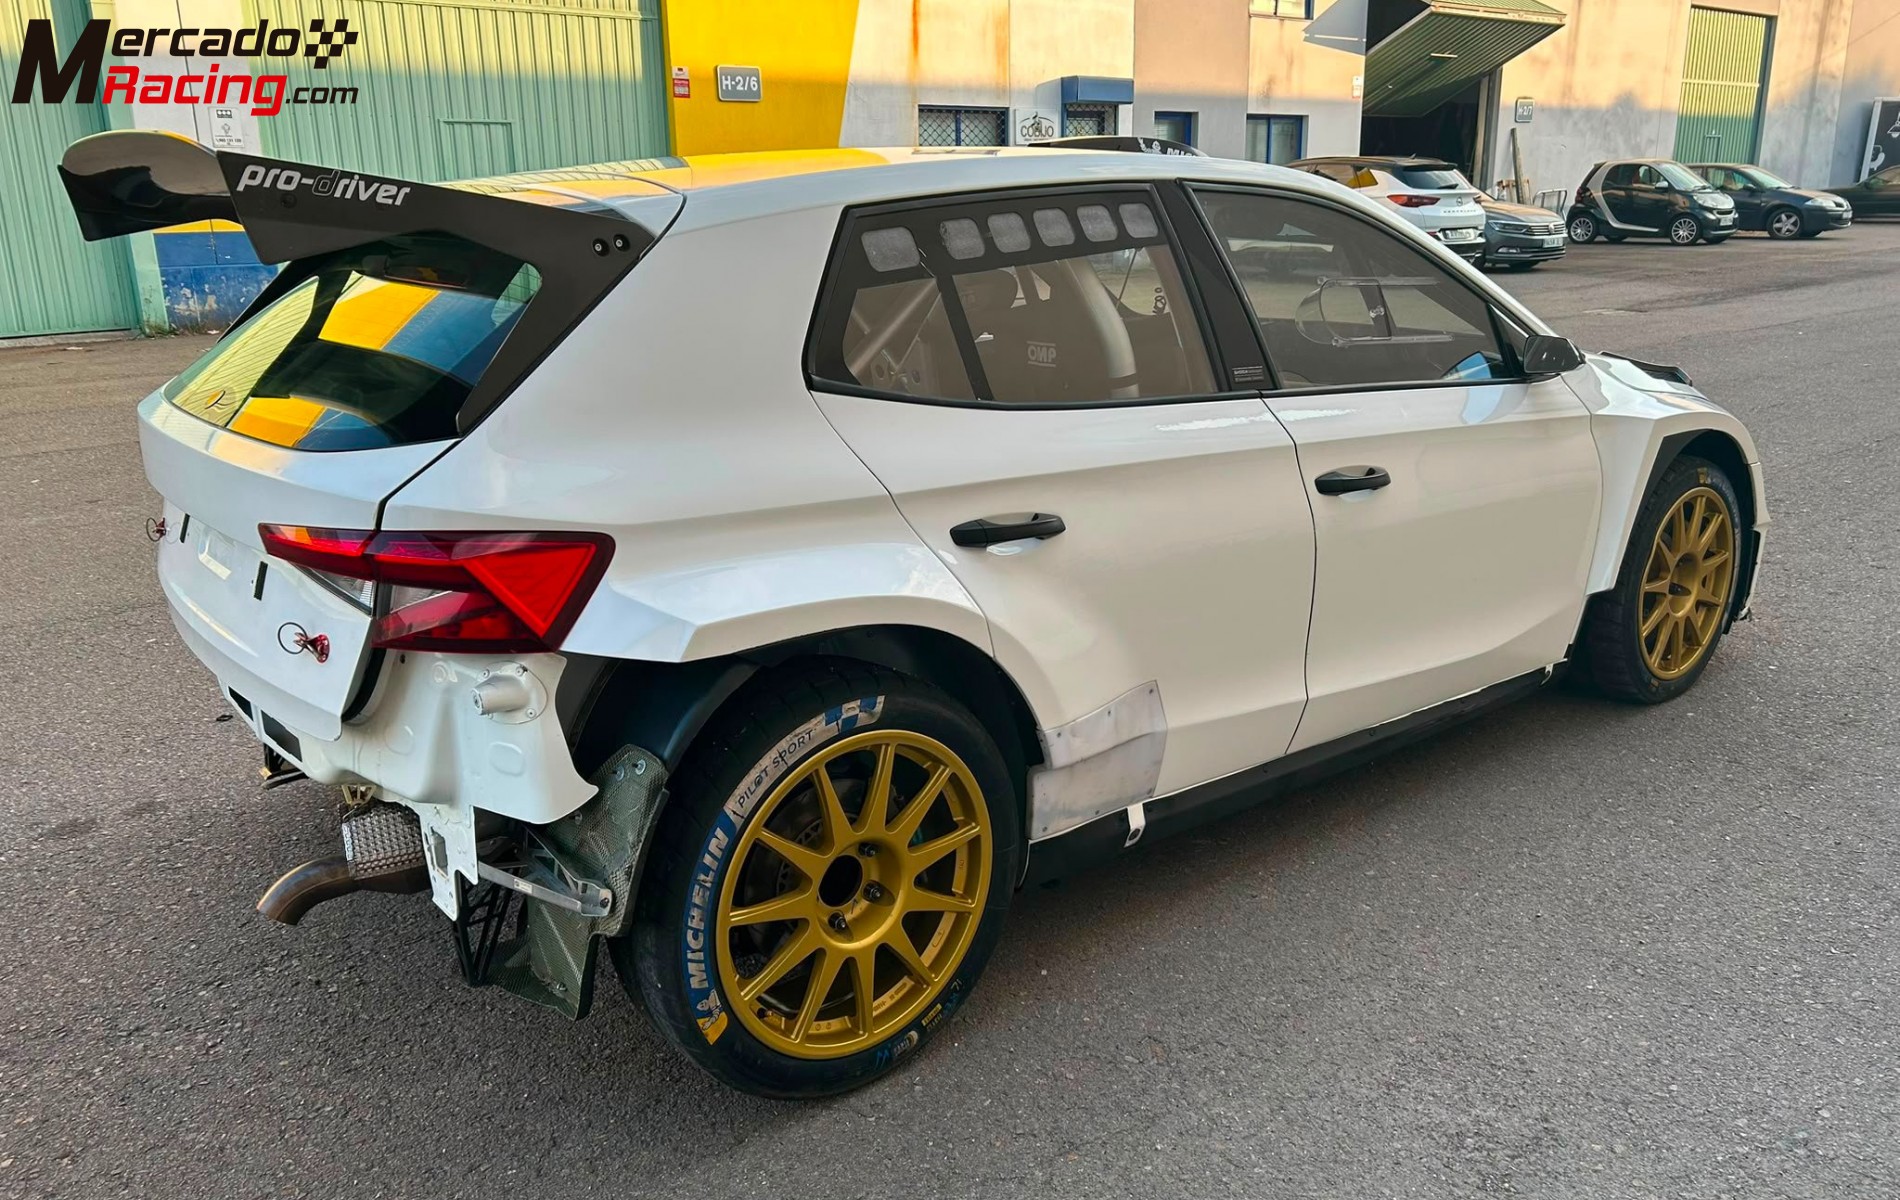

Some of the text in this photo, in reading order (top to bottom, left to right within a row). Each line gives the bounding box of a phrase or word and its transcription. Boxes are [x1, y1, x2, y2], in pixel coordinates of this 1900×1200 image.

[721, 75, 758, 91] H-2/6
[236, 165, 411, 206] pro-driver
[737, 728, 814, 808] PILOT SPORT
[687, 827, 729, 989] MICHELIN
